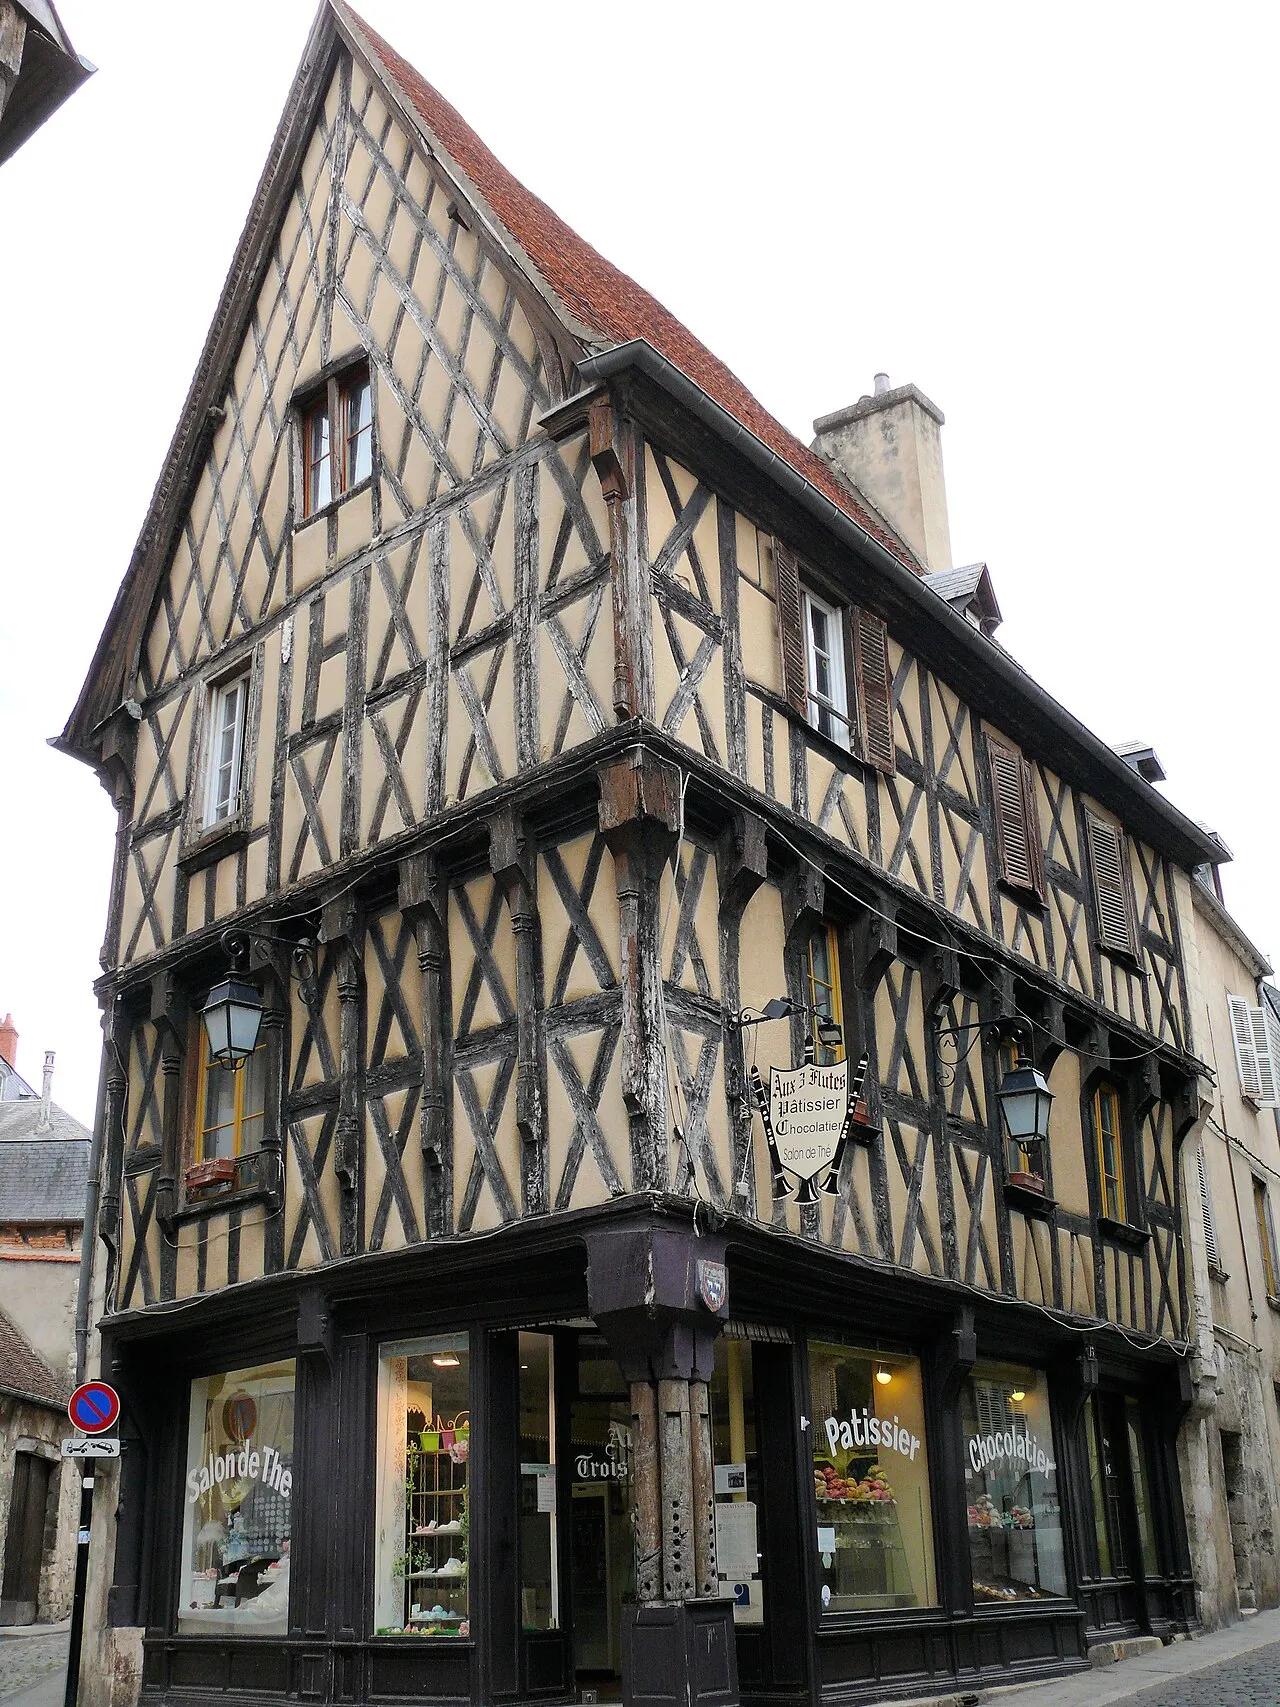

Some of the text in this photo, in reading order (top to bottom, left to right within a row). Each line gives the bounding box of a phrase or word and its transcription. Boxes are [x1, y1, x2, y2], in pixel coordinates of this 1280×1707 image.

[772, 1068, 846, 1098] Aux 3 Flutes
[778, 1097, 841, 1118] Pâtissier
[775, 1119, 842, 1136] Chocolatier
[783, 1147, 804, 1161] Salon
[806, 1146, 816, 1159] de
[825, 1408, 920, 1461] Patissier
[575, 1452, 628, 1480] Trois
[969, 1425, 1056, 1480] Chocolatier
[187, 1439, 292, 1503] Salon de The
